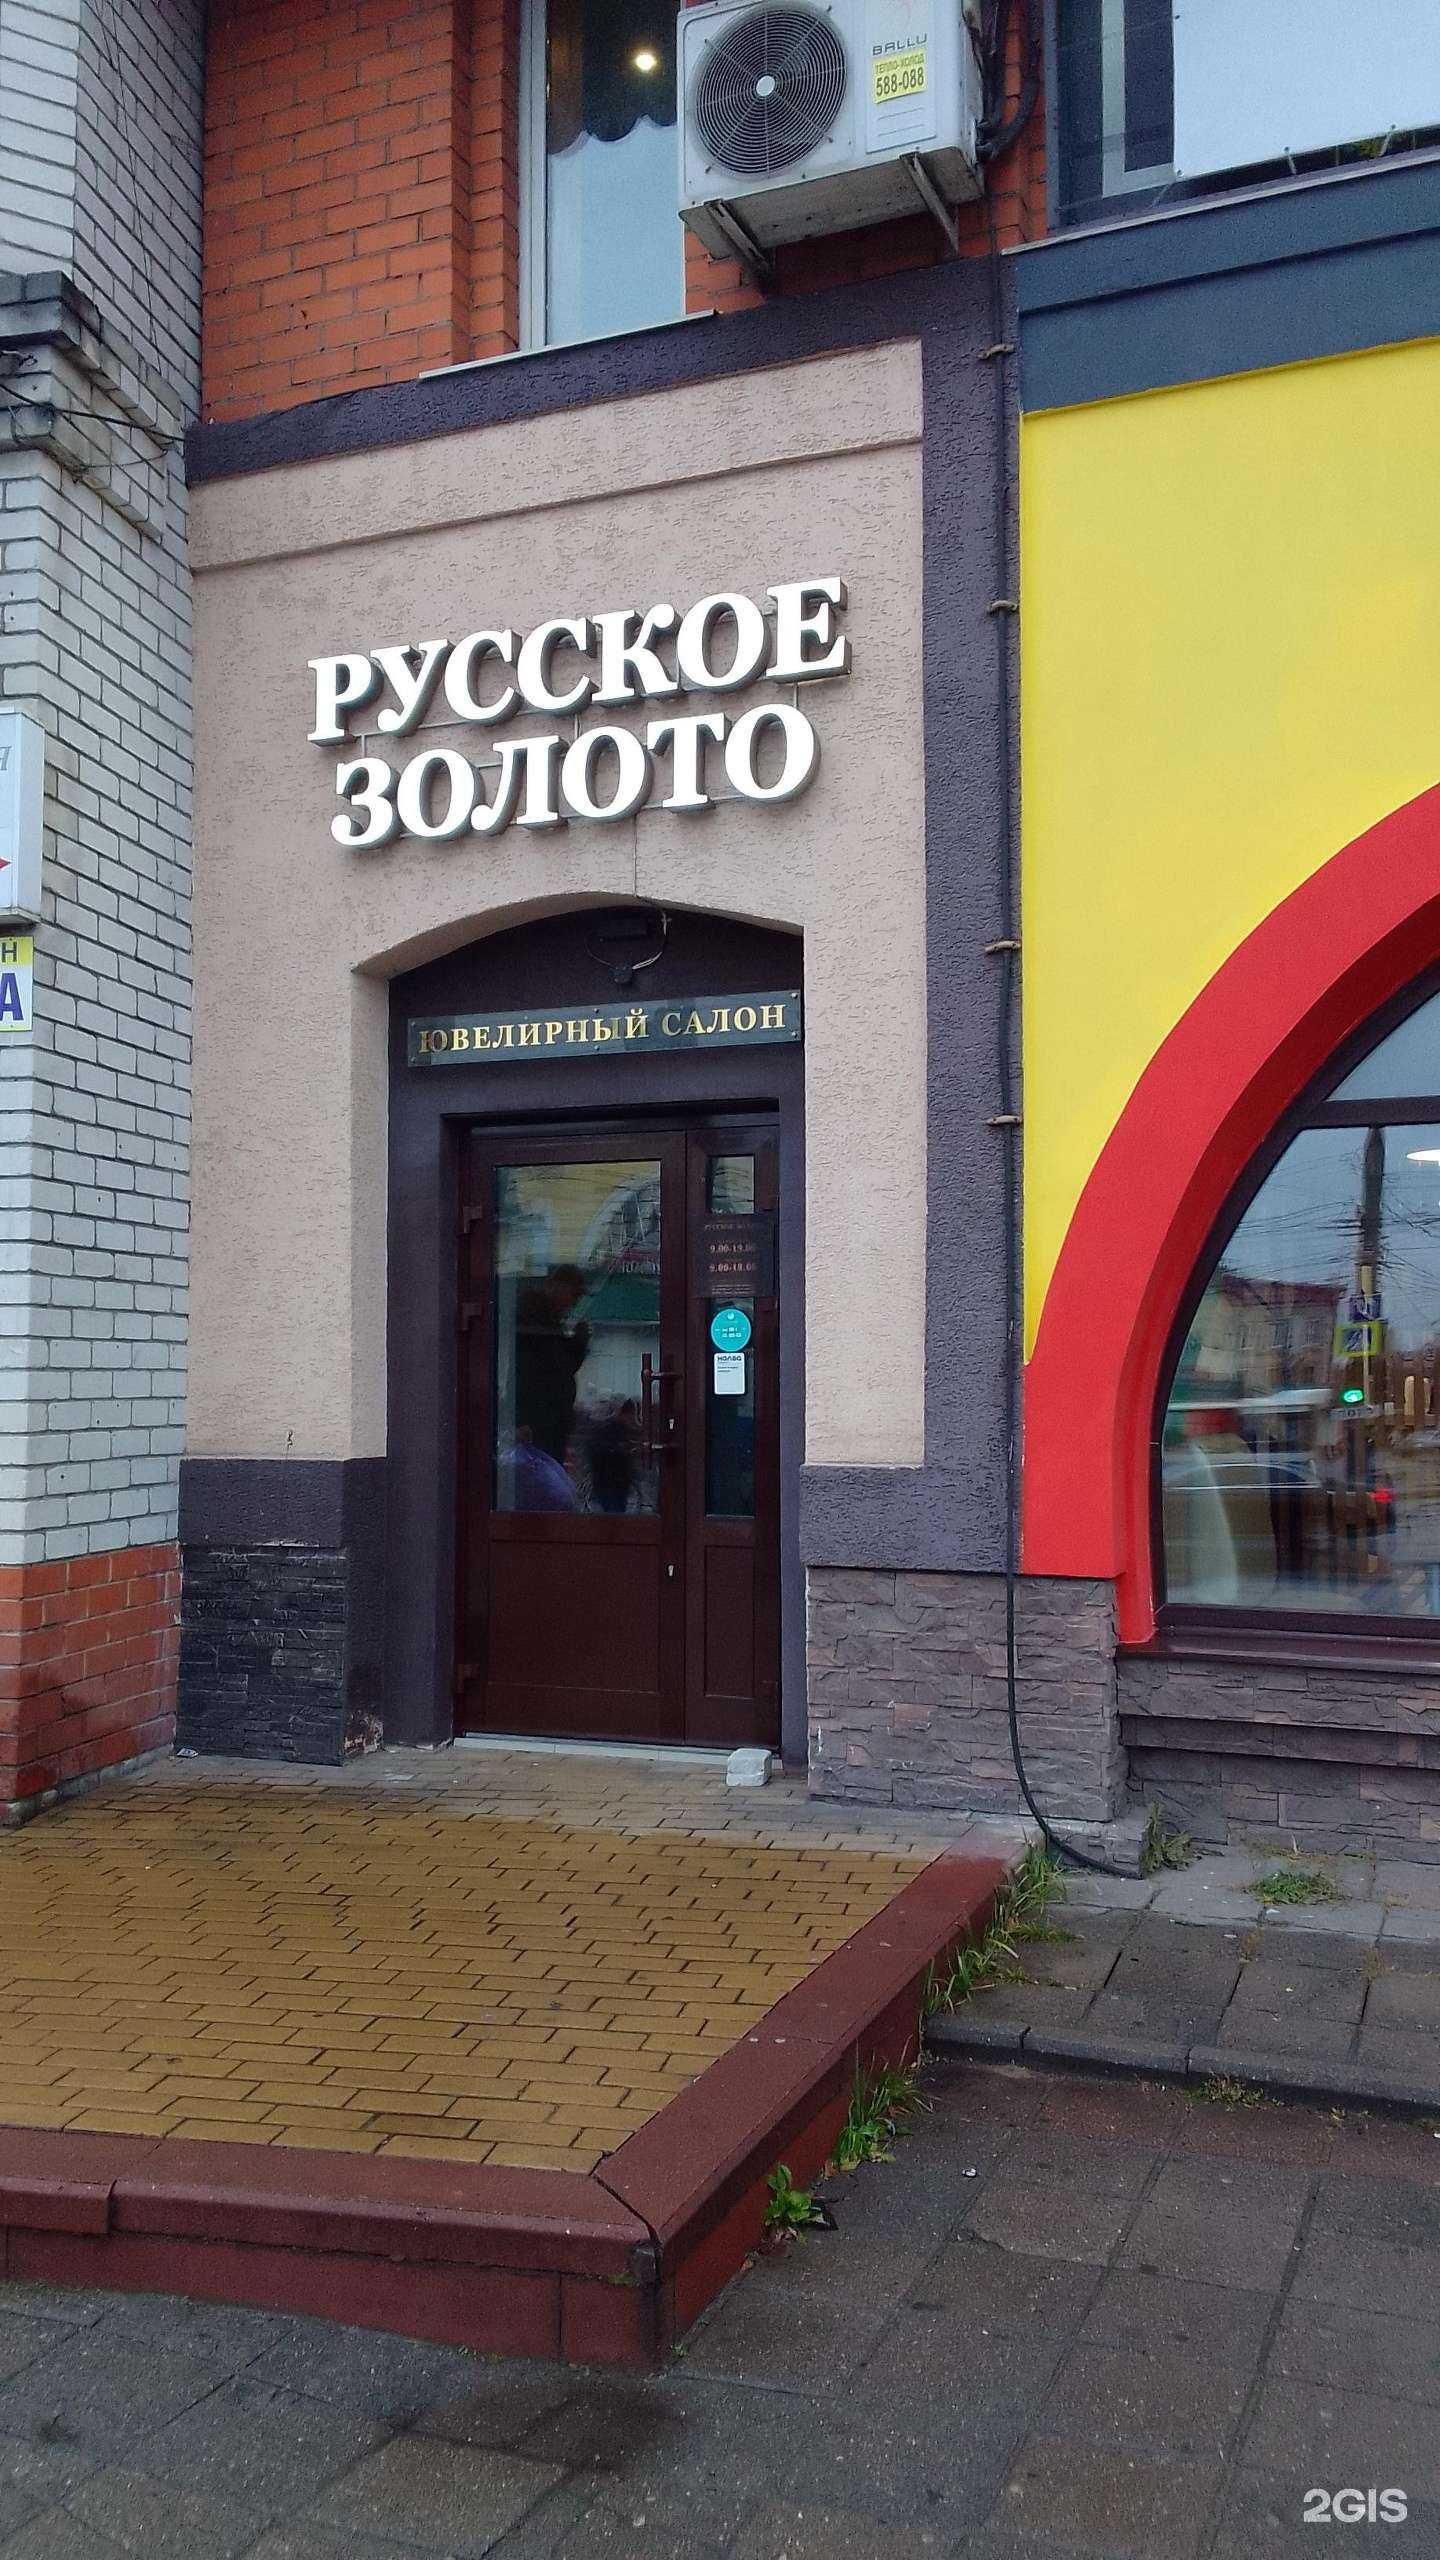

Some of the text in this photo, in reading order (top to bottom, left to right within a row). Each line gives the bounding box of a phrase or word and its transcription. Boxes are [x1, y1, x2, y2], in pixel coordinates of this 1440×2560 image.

[872, 33, 927, 56] BALLU
[876, 66, 924, 97] 588-088
[307, 577, 848, 745] РУССКОЕ
[330, 703, 820, 849] ЗОЛОТО
[419, 1004, 787, 1054] ЮВЕЛИРНЫЙ САЛОН
